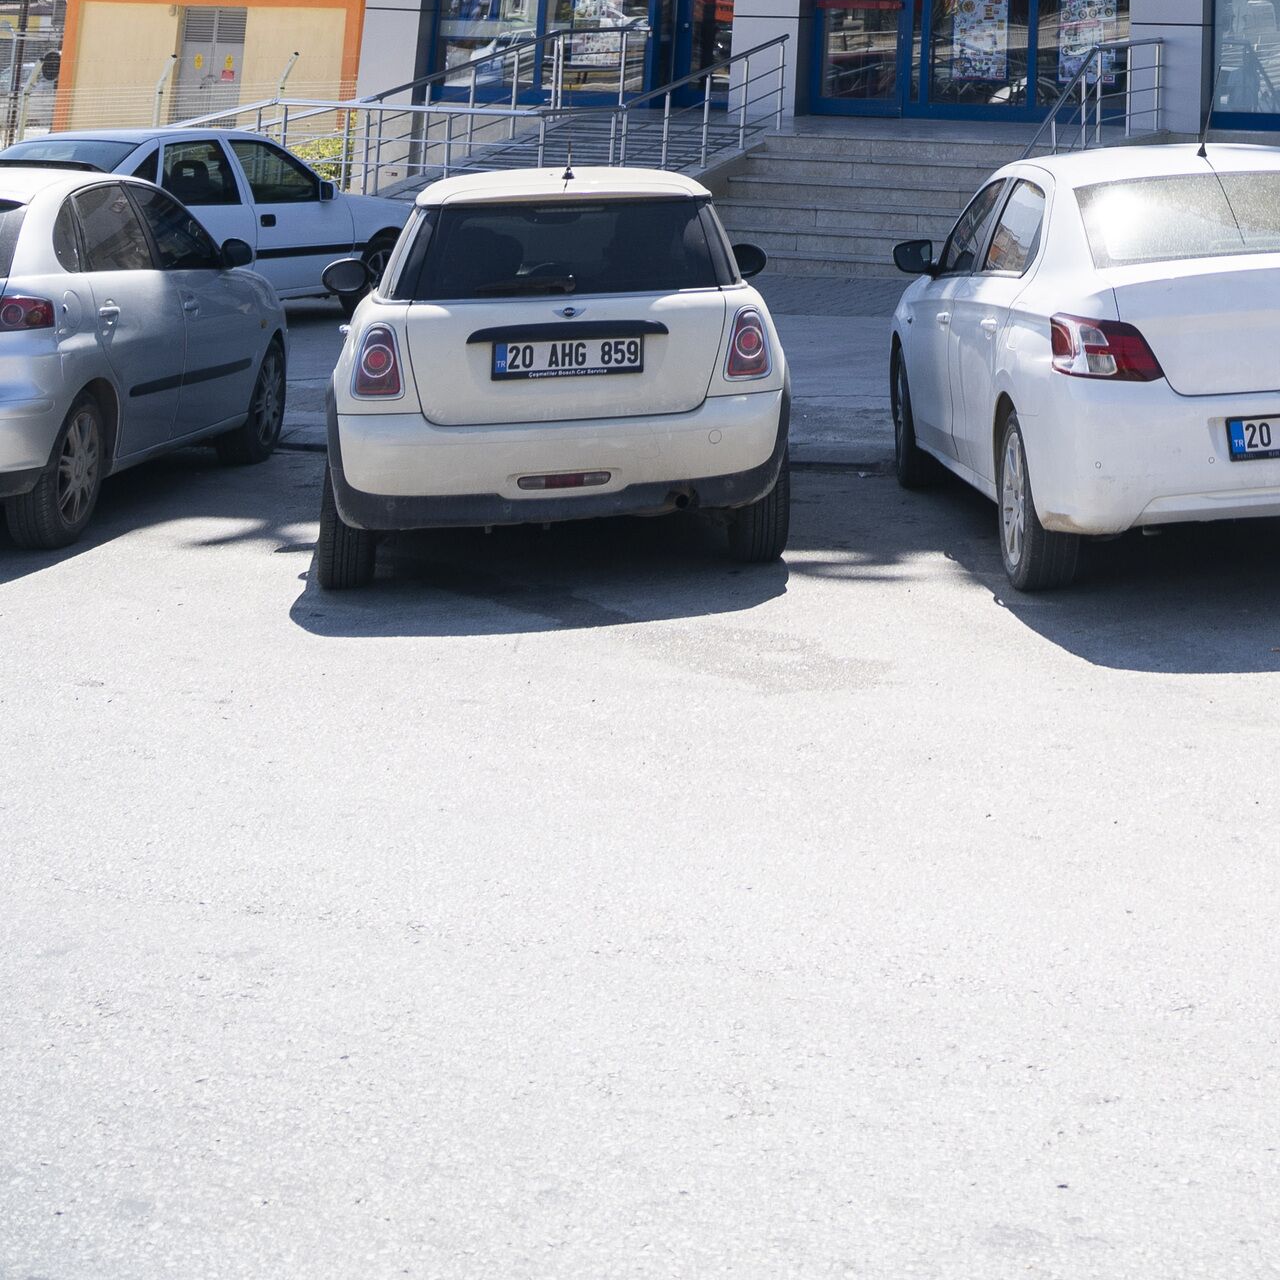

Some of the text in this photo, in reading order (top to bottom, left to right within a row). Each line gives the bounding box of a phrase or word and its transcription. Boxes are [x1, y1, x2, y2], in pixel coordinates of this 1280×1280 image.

[497, 340, 639, 370] TR 20 AHG 859
[1234, 439, 1244, 447] TR
[1245, 422, 1272, 449] 20
